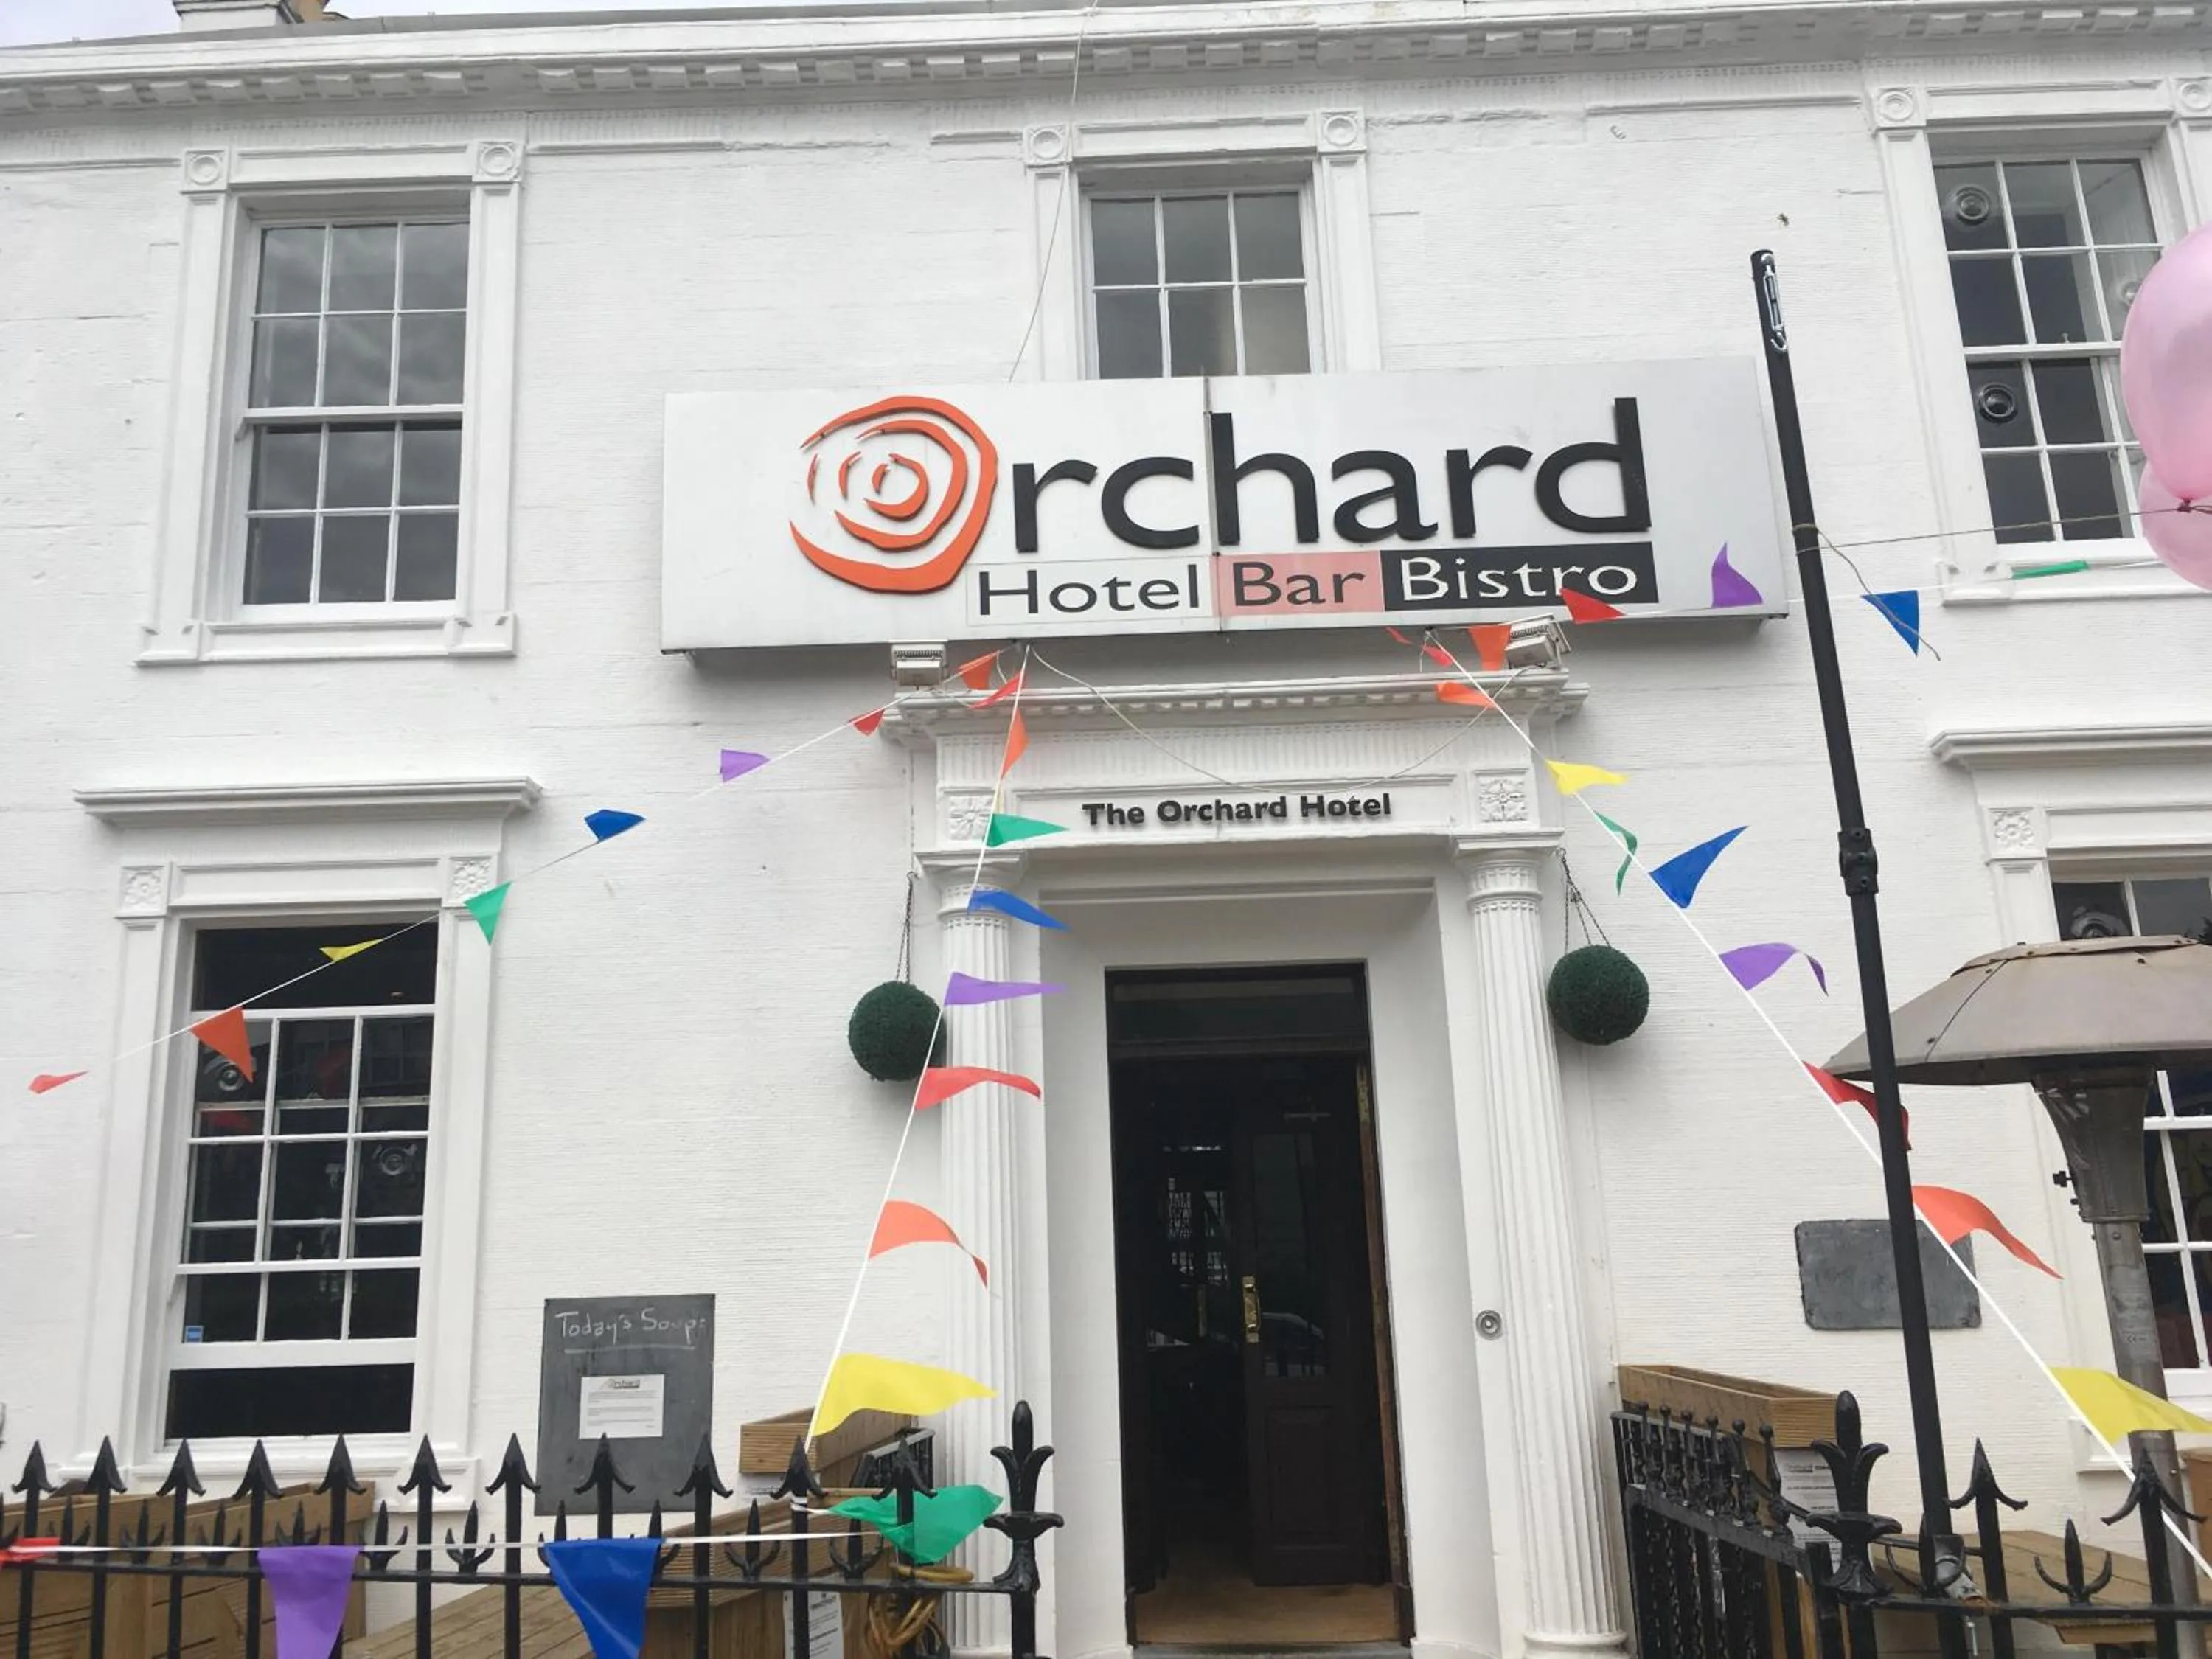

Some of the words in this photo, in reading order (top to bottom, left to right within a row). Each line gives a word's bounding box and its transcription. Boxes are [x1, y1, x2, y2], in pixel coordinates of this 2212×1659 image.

[979, 564, 1200, 616] Hotel
[1233, 560, 1365, 608] Bar
[1399, 556, 1638, 601] Bistro
[1082, 803, 1145, 826] The
[1156, 796, 1287, 823] Orchard
[1299, 793, 1391, 818] Hotel
[555, 1310, 632, 1346] Today's
